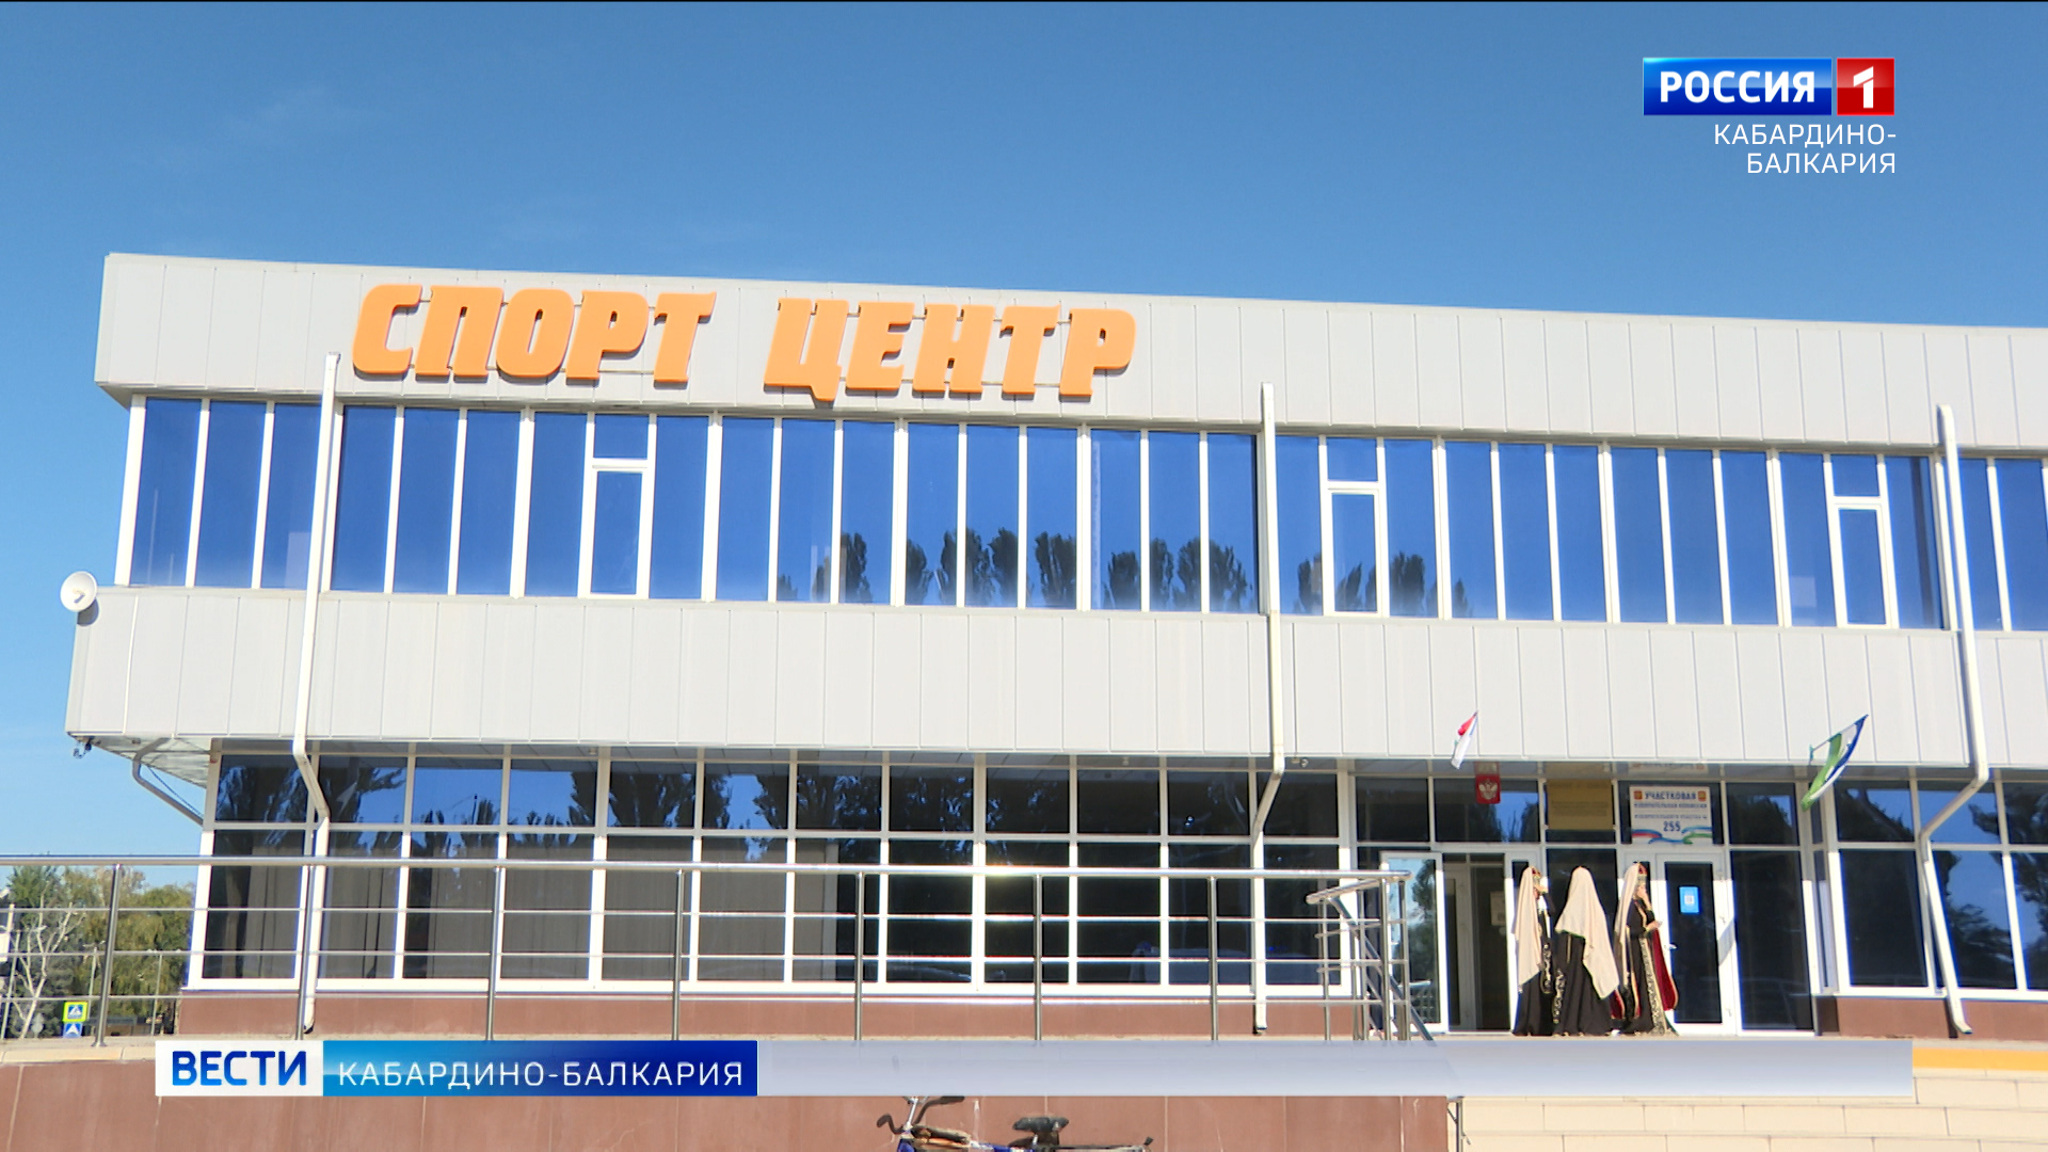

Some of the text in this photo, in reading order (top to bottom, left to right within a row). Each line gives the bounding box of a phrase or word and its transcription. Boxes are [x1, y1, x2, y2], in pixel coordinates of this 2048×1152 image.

[353, 284, 1137, 402] СПОРТ ЦЕНТР
[1645, 791, 1697, 800] УЧАСТКОВАЯ
